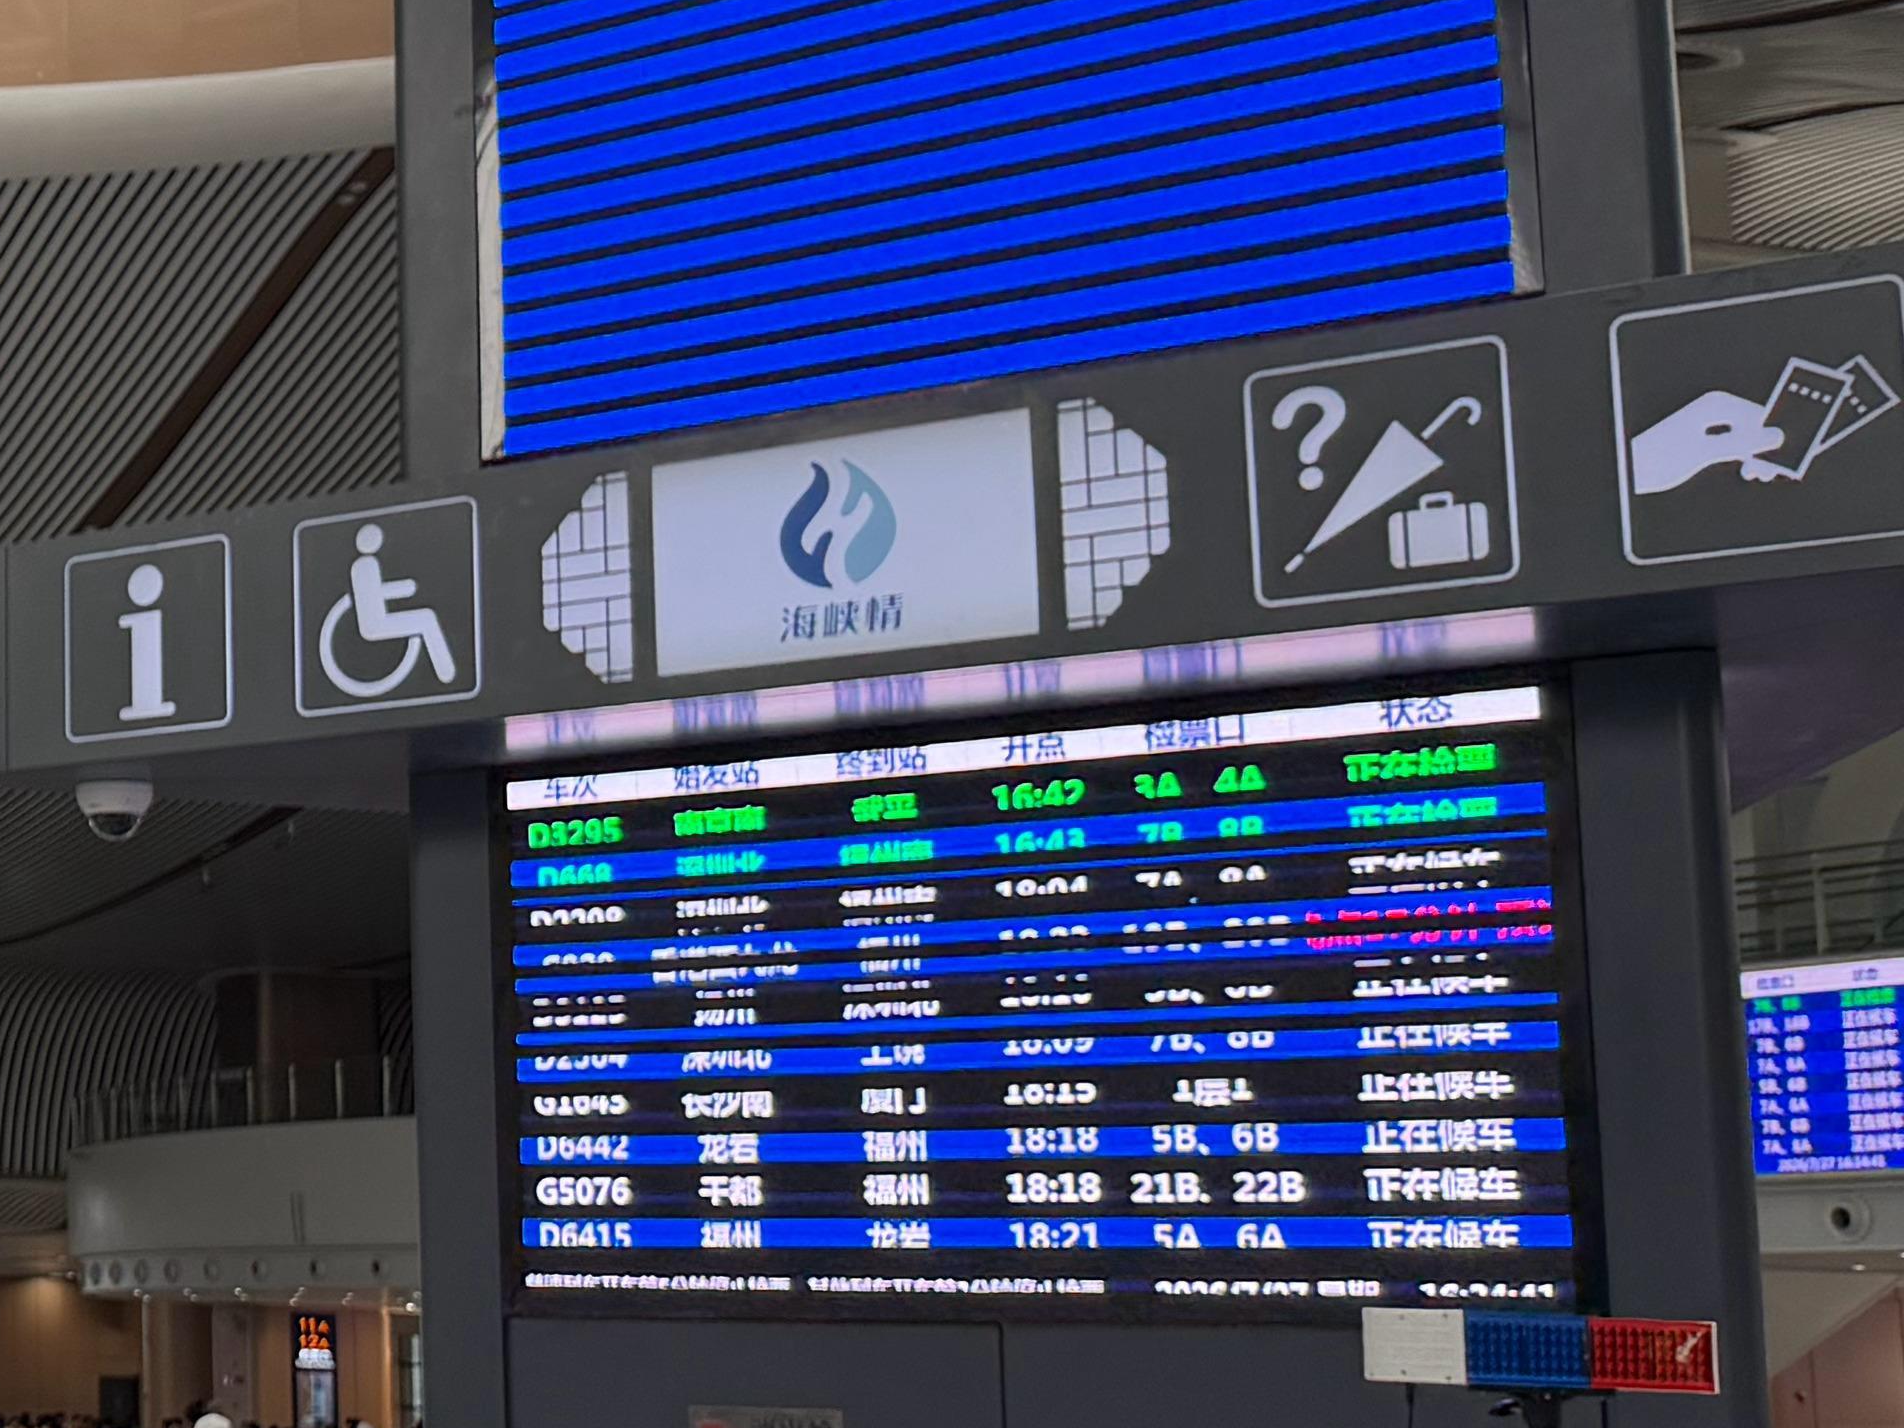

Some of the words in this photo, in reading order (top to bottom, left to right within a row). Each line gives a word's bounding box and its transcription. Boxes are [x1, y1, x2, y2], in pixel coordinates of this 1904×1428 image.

[779, 593, 905, 646] 海峡情
[543, 774, 600, 802] 车次
[673, 763, 760, 794] 始发站
[835, 747, 929, 779] 终到站
[1379, 696, 1454, 729] 状态
[528, 815, 625, 850] D3295
[536, 1134, 630, 1162] D6442
[697, 1132, 760, 1163] 龙岩
[862, 1129, 928, 1163] 福州
[1005, 1125, 1101, 1155] 18:18
[1361, 1117, 1518, 1155] 正在候车
[535, 1174, 634, 1206] G5076
[862, 1172, 932, 1206] 福州
[1005, 1171, 1104, 1204] 18:18
[1363, 1168, 1522, 1203] 正在候车
[538, 1220, 633, 1249] D6415
[700, 1219, 762, 1249] 福州
[865, 1218, 933, 1250] 龙岩
[1008, 1220, 1099, 1249] 18:21
[1367, 1219, 1521, 1251] 正在候车
